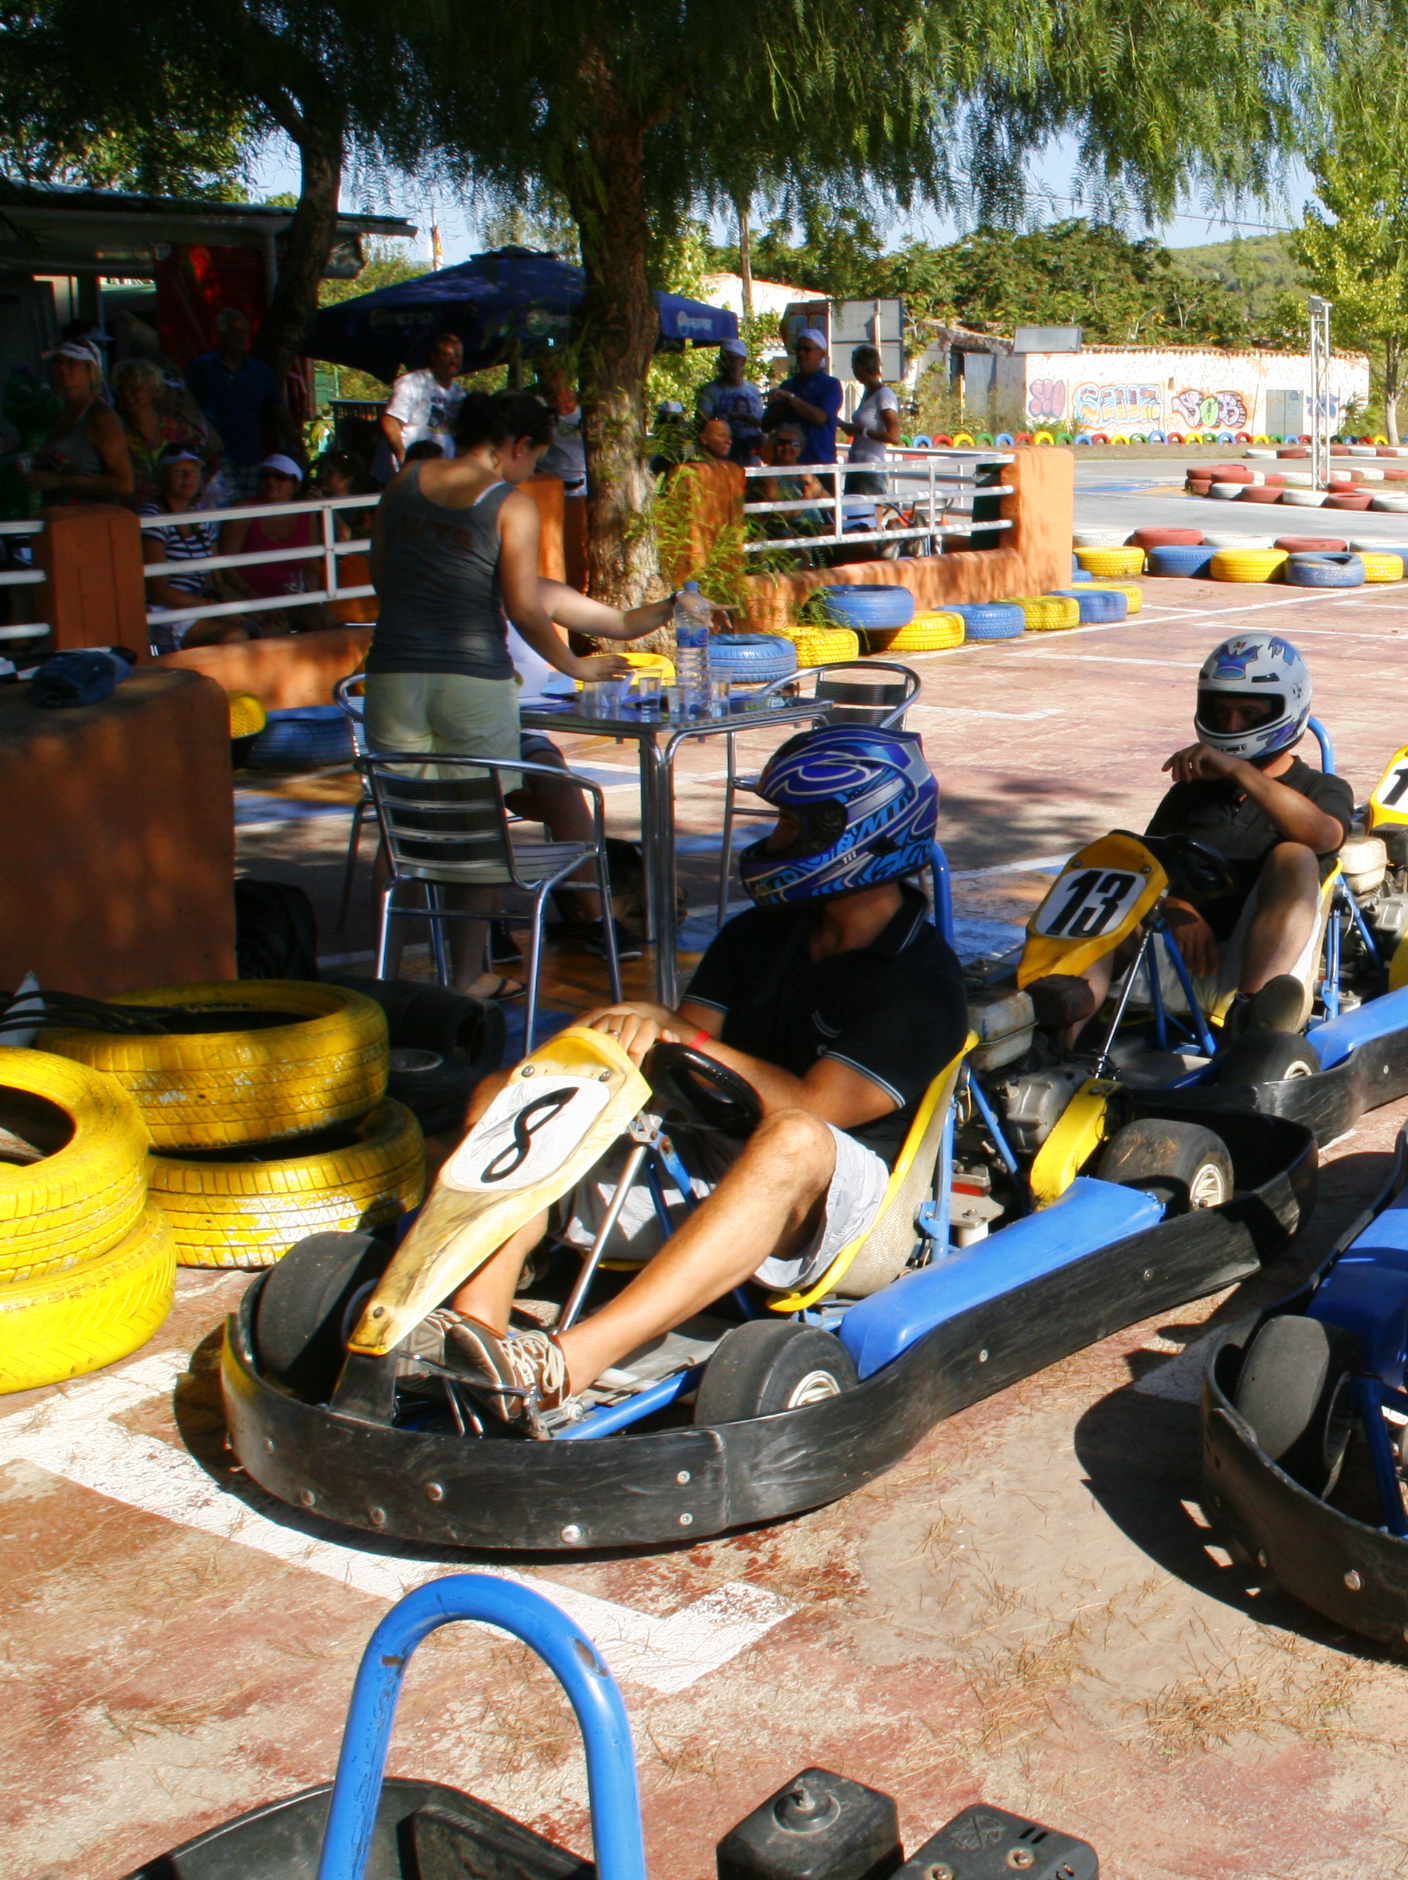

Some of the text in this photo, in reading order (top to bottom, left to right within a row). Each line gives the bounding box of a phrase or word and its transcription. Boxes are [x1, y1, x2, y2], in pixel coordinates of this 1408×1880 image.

[686, 317, 713, 332] PEPSI
[1044, 870, 1136, 937] 13
[481, 1086, 580, 1183] 8
